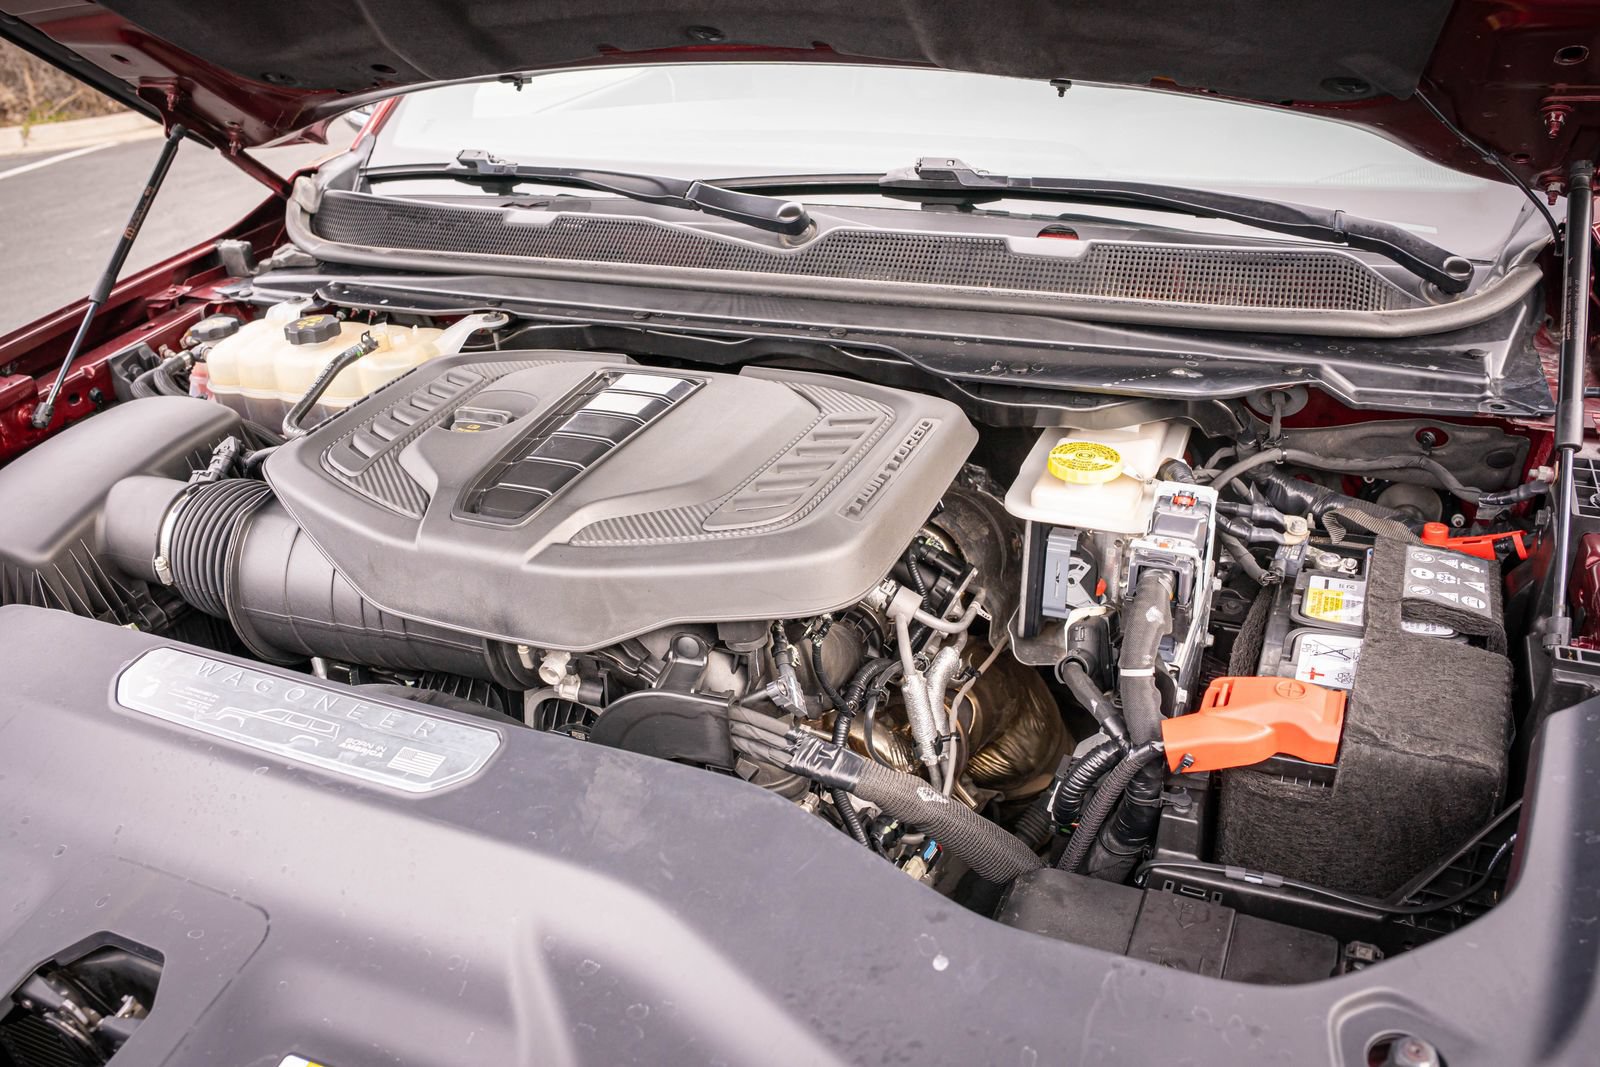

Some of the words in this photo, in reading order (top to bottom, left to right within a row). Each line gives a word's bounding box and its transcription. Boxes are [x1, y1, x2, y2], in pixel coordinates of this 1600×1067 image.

[845, 472, 892, 517] TWIN
[884, 420, 934, 472] TURBO
[194, 660, 437, 738] WAGONEER
[338, 742, 383, 758] AMERICA
[345, 738, 375, 749] BORN
[376, 744, 387, 753] IN
